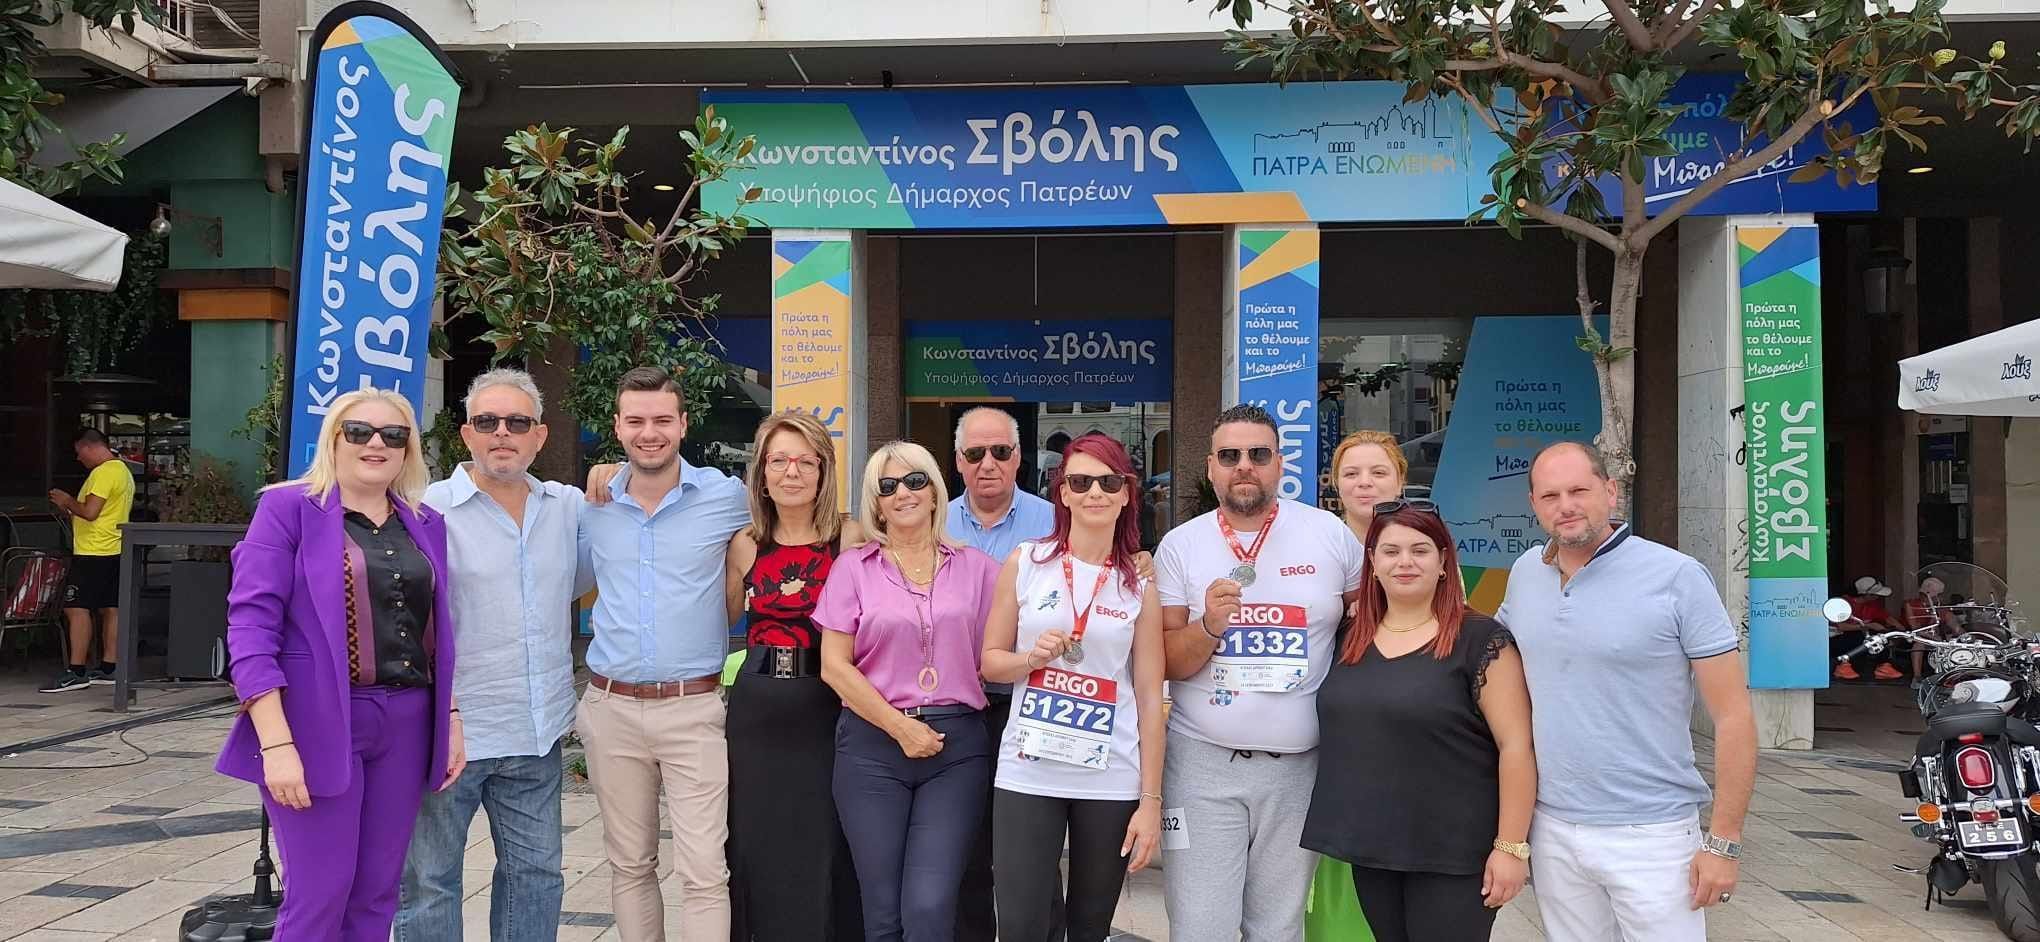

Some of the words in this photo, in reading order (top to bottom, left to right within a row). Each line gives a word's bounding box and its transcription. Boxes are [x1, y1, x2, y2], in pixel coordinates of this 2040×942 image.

[965, 109, 1180, 175] Σβόλης
[1252, 156, 1329, 176] ΠΑΤΡΑ
[886, 181, 1011, 209] Δήμαρχος
[1020, 181, 1133, 206] Πατρέων
[306, 55, 370, 417] Κωνσταντίνος
[1245, 303, 1286, 316] Πρώτα
[1288, 305, 1296, 316] η
[1746, 302, 1786, 315] Πρώτα
[1789, 304, 1797, 315] η
[781, 311, 819, 324] Πρώτα
[822, 314, 829, 325] η
[1245, 317, 1274, 331] πόλη
[1277, 320, 1300, 331] μας
[1746, 317, 1775, 330] πόλη
[1778, 320, 1801, 330] μας
[781, 326, 809, 338] πόλη
[811, 328, 833, 338] μας
[1244, 336, 1259, 344] το
[1261, 333, 1311, 346] θέλουμε
[1746, 336, 1760, 344] το
[1762, 333, 1813, 346] θέλουμε
[781, 344, 794, 352] το
[796, 341, 843, 354] θέλουμε
[922, 344, 1038, 362] Κωνσταντίνος
[1043, 331, 1157, 365] Σβόλης
[1244, 347, 1263, 356] και
[1266, 347, 1280, 356] το
[1746, 348, 1765, 356] και
[1768, 348, 1782, 356] το
[781, 354, 798, 363] και
[801, 355, 814, 363] το
[924, 371, 998, 385] Υποψήφιος
[1002, 371, 1070, 385] Δήμαρχος
[1074, 371, 1135, 385] Πατρέων
[1495, 378, 1547, 394] Πρώτα
[1552, 382, 1561, 394] η
[1495, 398, 1532, 413] πόλη
[1537, 401, 1567, 413] μας
[1494, 423, 1512, 432] το
[1517, 418, 1581, 434] θέλουμε
[1747, 401, 1771, 562] Κωνσταντίνος
[1769, 400, 1819, 561] Σβόλης
[1456, 538, 1501, 553] ΑΤΡΑ
[1280, 564, 1316, 577] ERGO
[1095, 604, 1129, 620] ERGO
[1043, 670, 1098, 697] ERGO
[1022, 691, 1112, 732] 51272
[1969, 829, 2015, 843] 256
